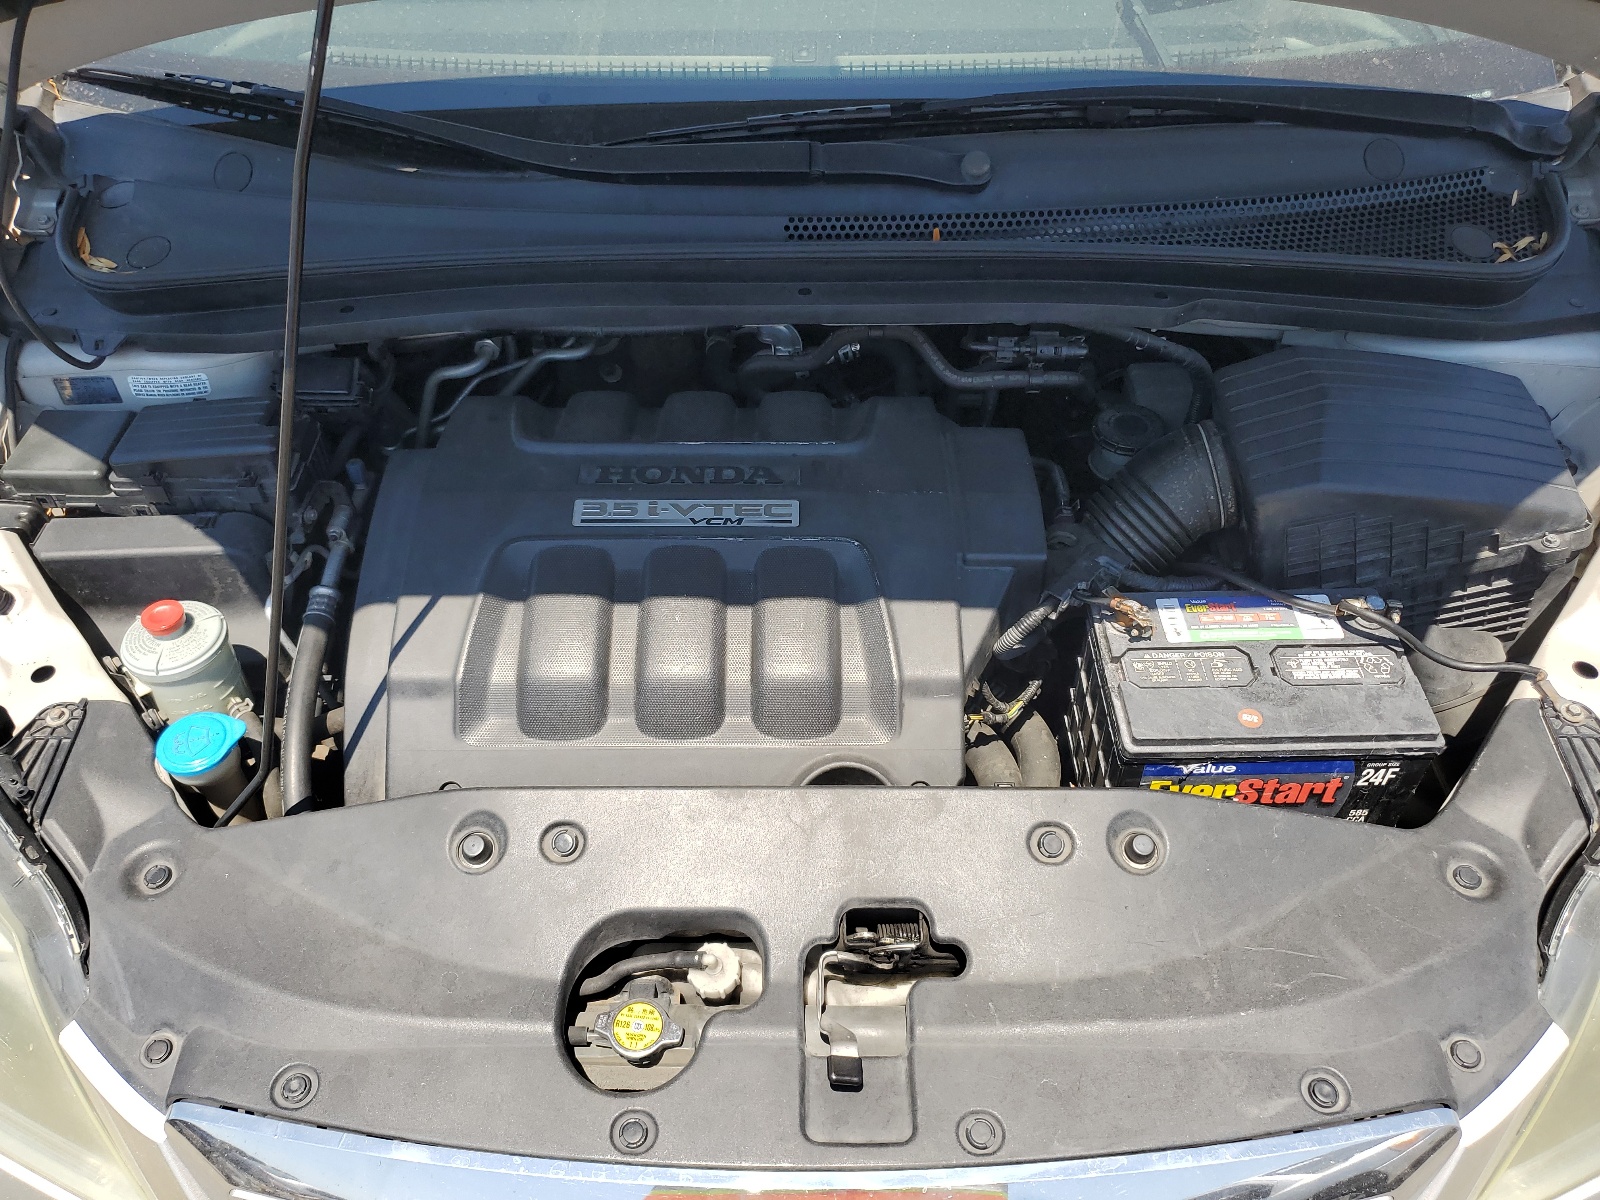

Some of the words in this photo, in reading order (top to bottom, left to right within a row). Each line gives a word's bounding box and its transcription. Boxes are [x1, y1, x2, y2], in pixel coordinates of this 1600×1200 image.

[595, 465, 784, 485] HONDA
[581, 501, 639, 518] 3.5
[647, 501, 793, 518] i-VTEC
[689, 517, 745, 526] VCM
[1182, 763, 1237, 775] Value
[1356, 768, 1400, 786] 24F
